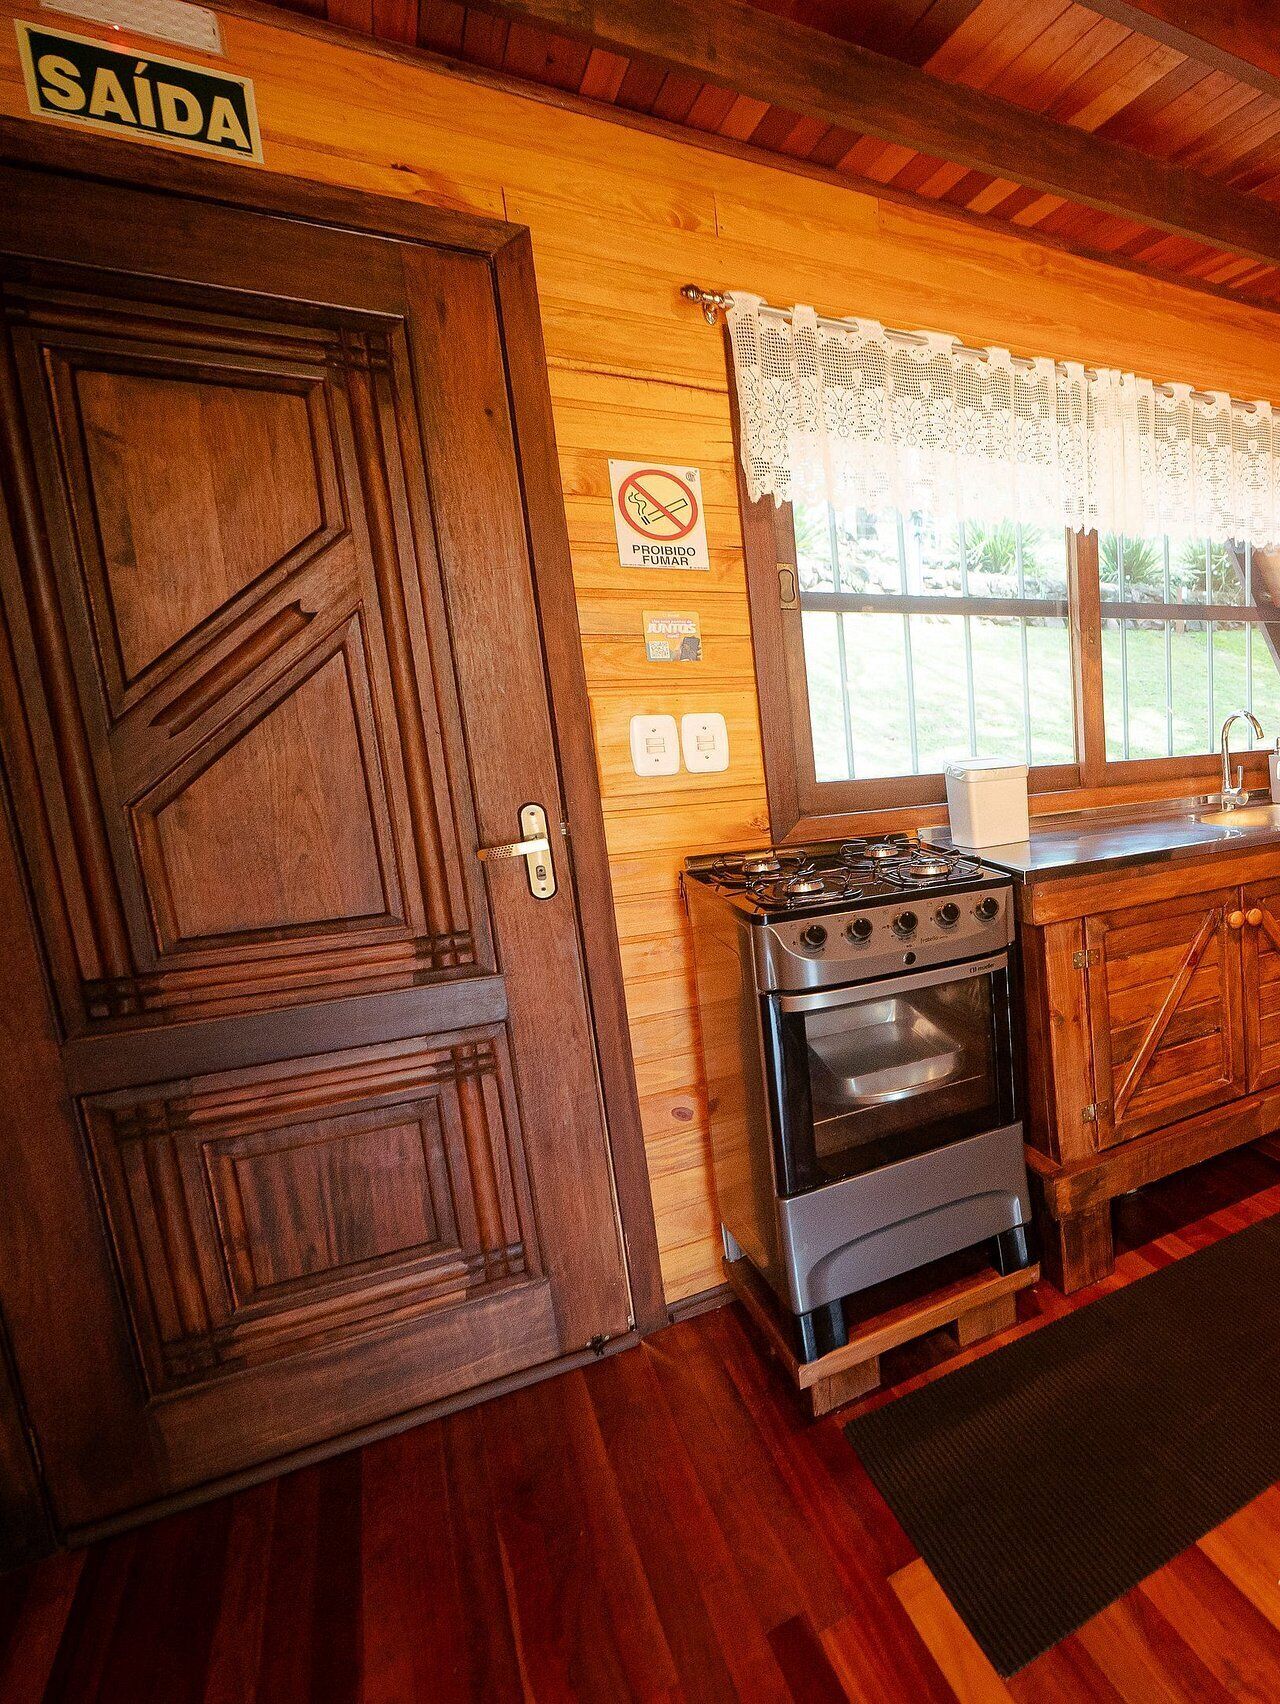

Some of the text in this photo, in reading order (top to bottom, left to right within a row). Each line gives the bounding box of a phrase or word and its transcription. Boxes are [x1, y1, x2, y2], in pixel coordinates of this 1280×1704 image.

[38, 55, 250, 149] SAÍDA
[632, 544, 696, 557] PROIBIDO
[642, 555, 689, 566] FUMAR
[647, 623, 697, 634] JUNTOS
